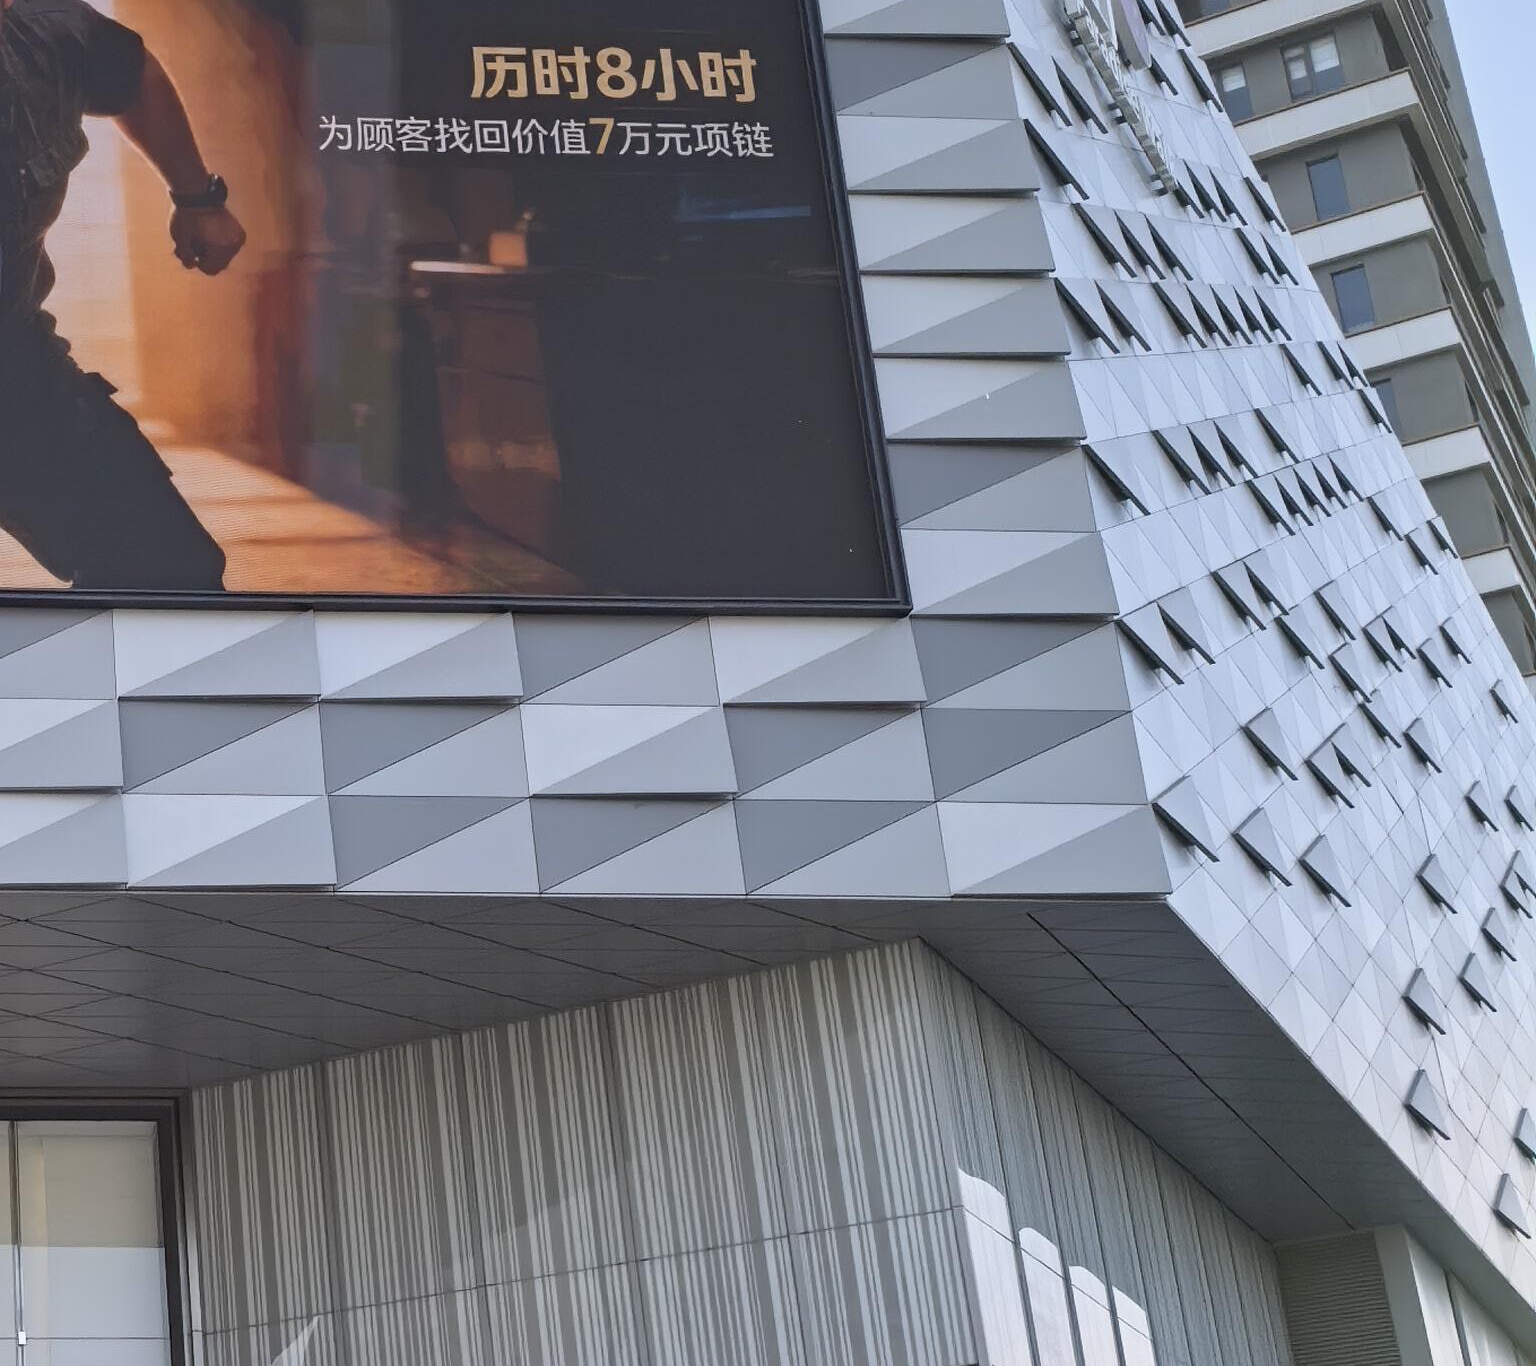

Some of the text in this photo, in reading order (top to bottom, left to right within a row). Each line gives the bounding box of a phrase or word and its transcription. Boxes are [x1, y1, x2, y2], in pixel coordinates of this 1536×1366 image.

[469, 45, 758, 103] 历时8小时
[317, 115, 775, 159] 为顾客找回价值7万元项链
